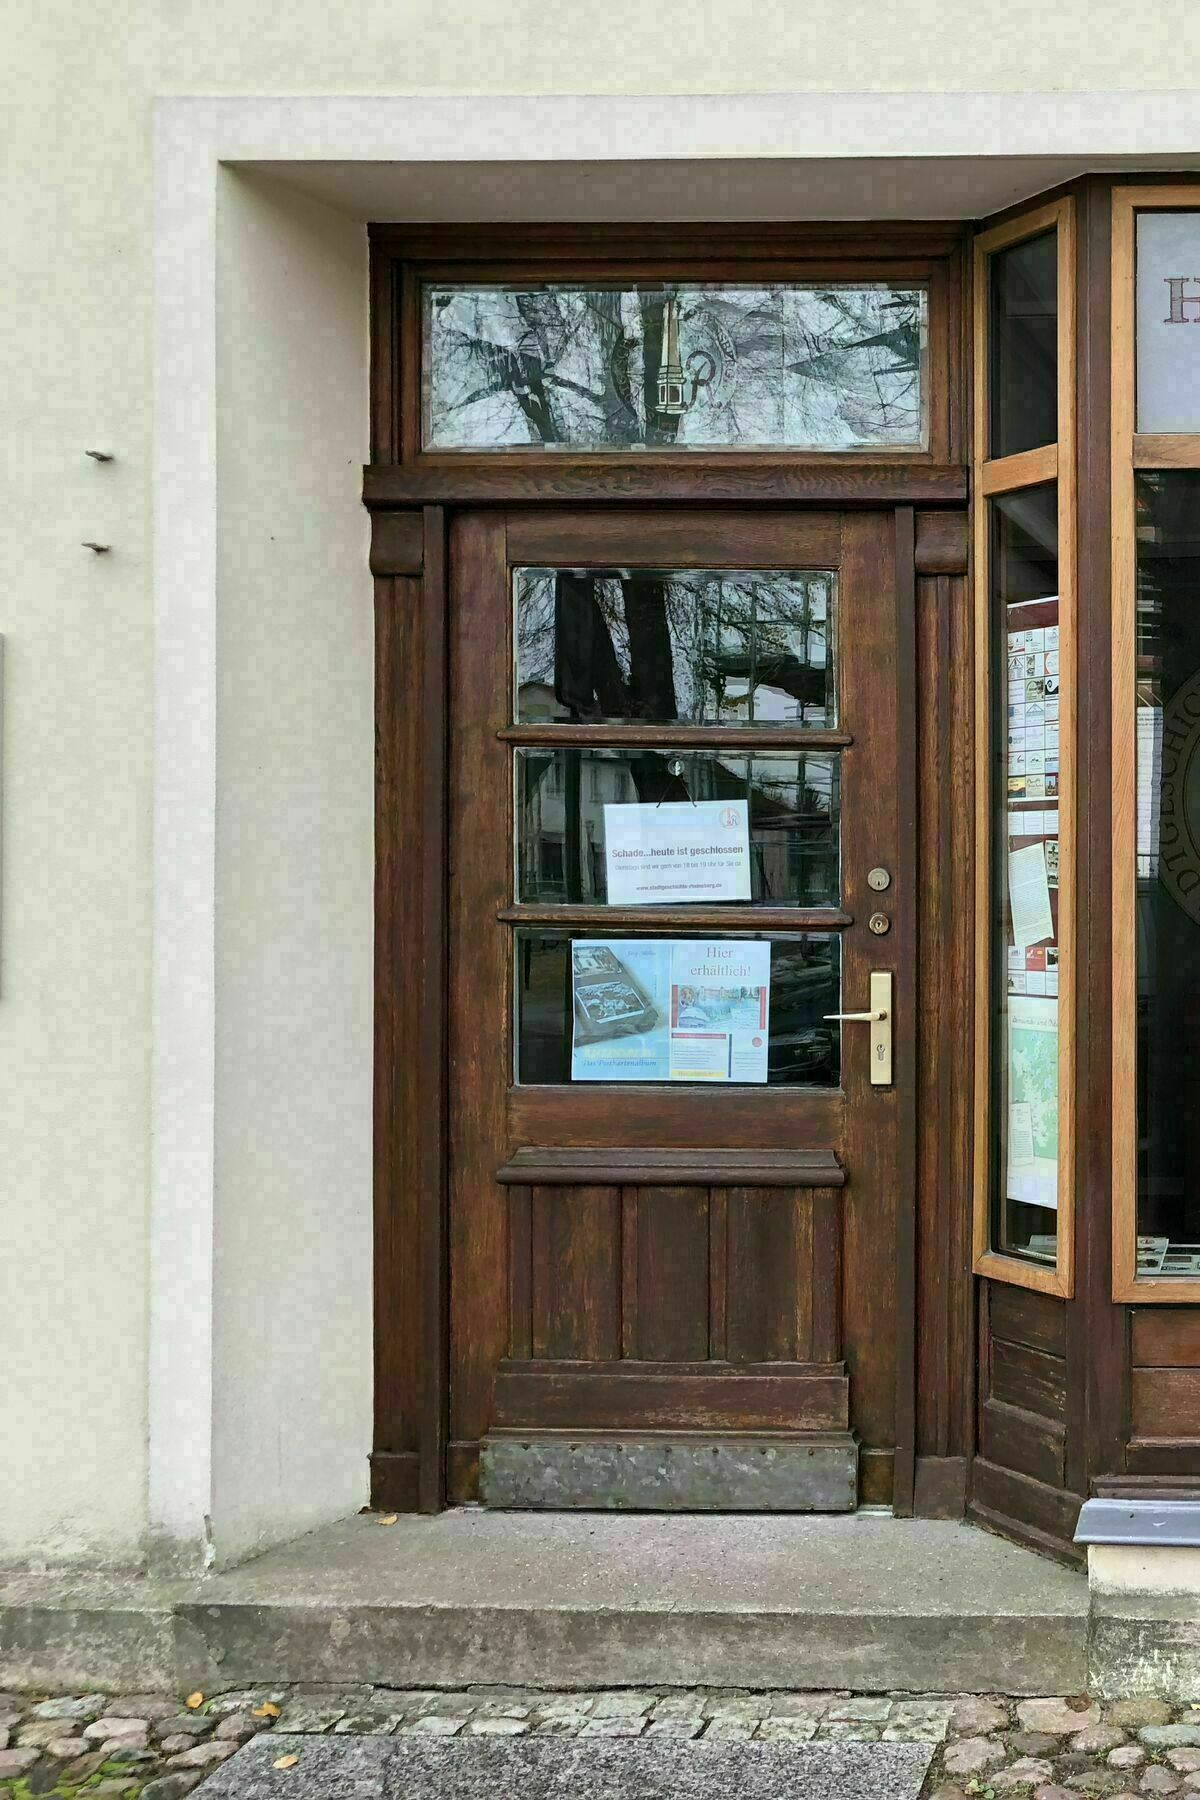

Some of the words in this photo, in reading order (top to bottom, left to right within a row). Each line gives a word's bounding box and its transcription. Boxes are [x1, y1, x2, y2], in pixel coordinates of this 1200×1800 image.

[677, 846, 688, 856] ist
[690, 845, 743, 857] geschlossen
[706, 947, 734, 959] Hier
[690, 964, 751, 977] erhältlich!
